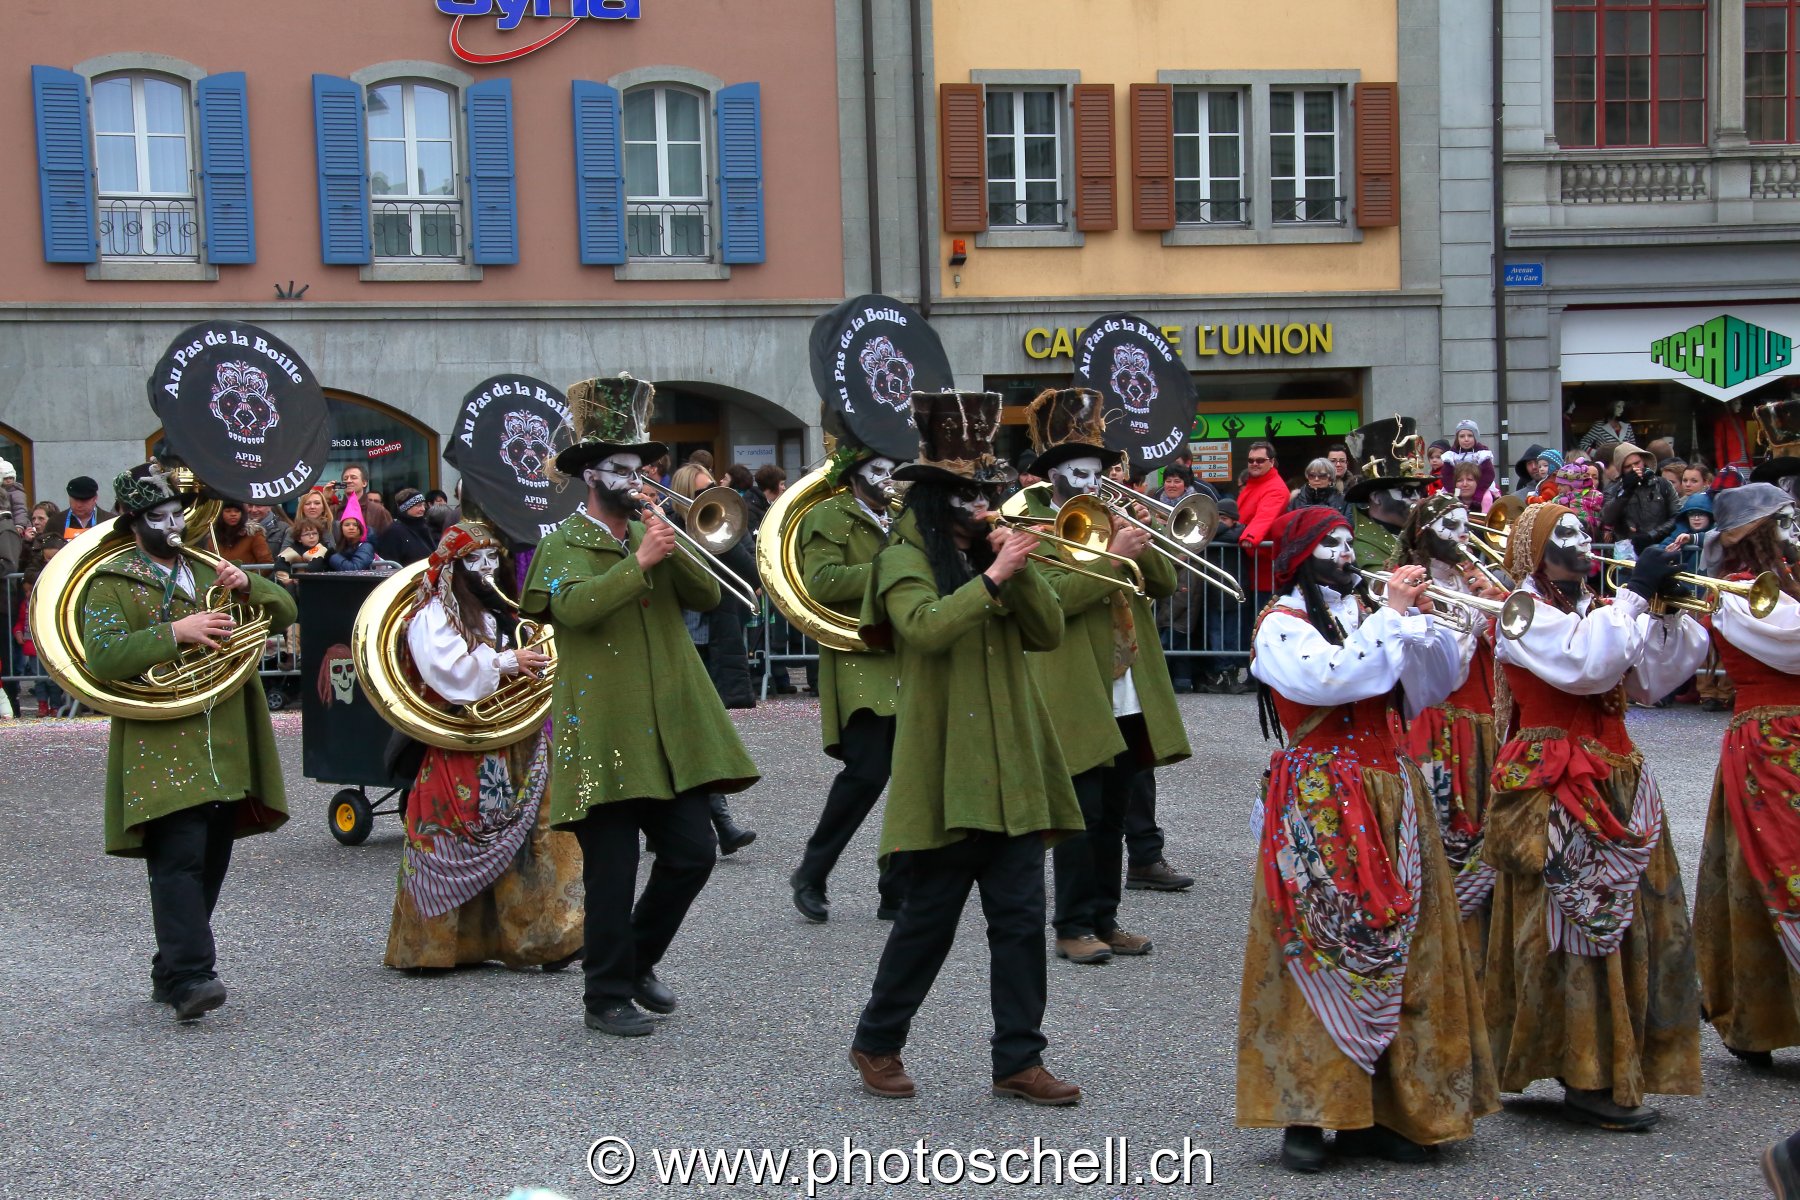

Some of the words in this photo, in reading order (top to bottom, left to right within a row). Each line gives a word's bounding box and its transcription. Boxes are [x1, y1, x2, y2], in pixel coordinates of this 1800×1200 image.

[851, 317, 865, 332] la
[864, 307, 907, 327] Boille
[1104, 319, 1120, 332] de
[1122, 318, 1135, 331] la
[840, 329, 854, 349] de
[1085, 327, 1104, 352] Pas
[1138, 322, 1173, 363] Boille
[1198, 323, 1333, 356] L'UNION
[164, 366, 183, 400] Au
[174, 339, 204, 368] Pas
[204, 331, 227, 346] de
[230, 330, 249, 347] la
[253, 336, 303, 384] Boille
[834, 352, 846, 382] Pas
[1079, 353, 1092, 379] Au
[492, 382, 512, 398] de
[514, 381, 531, 397] la
[466, 391, 492, 418] Pas
[839, 386, 855, 414] Au
[460, 418, 475, 448] Au
[1130, 420, 1149, 429] APDB
[353, 439, 359, 447] à
[361, 439, 385, 447] 18h30
[368, 443, 402, 456] non-stop
[747, 448, 773, 456] randstad
[1141, 426, 1184, 460] BULLE
[235, 451, 262, 463] APDB
[250, 460, 313, 499] BULLE
[524, 495, 548, 505] APDB
